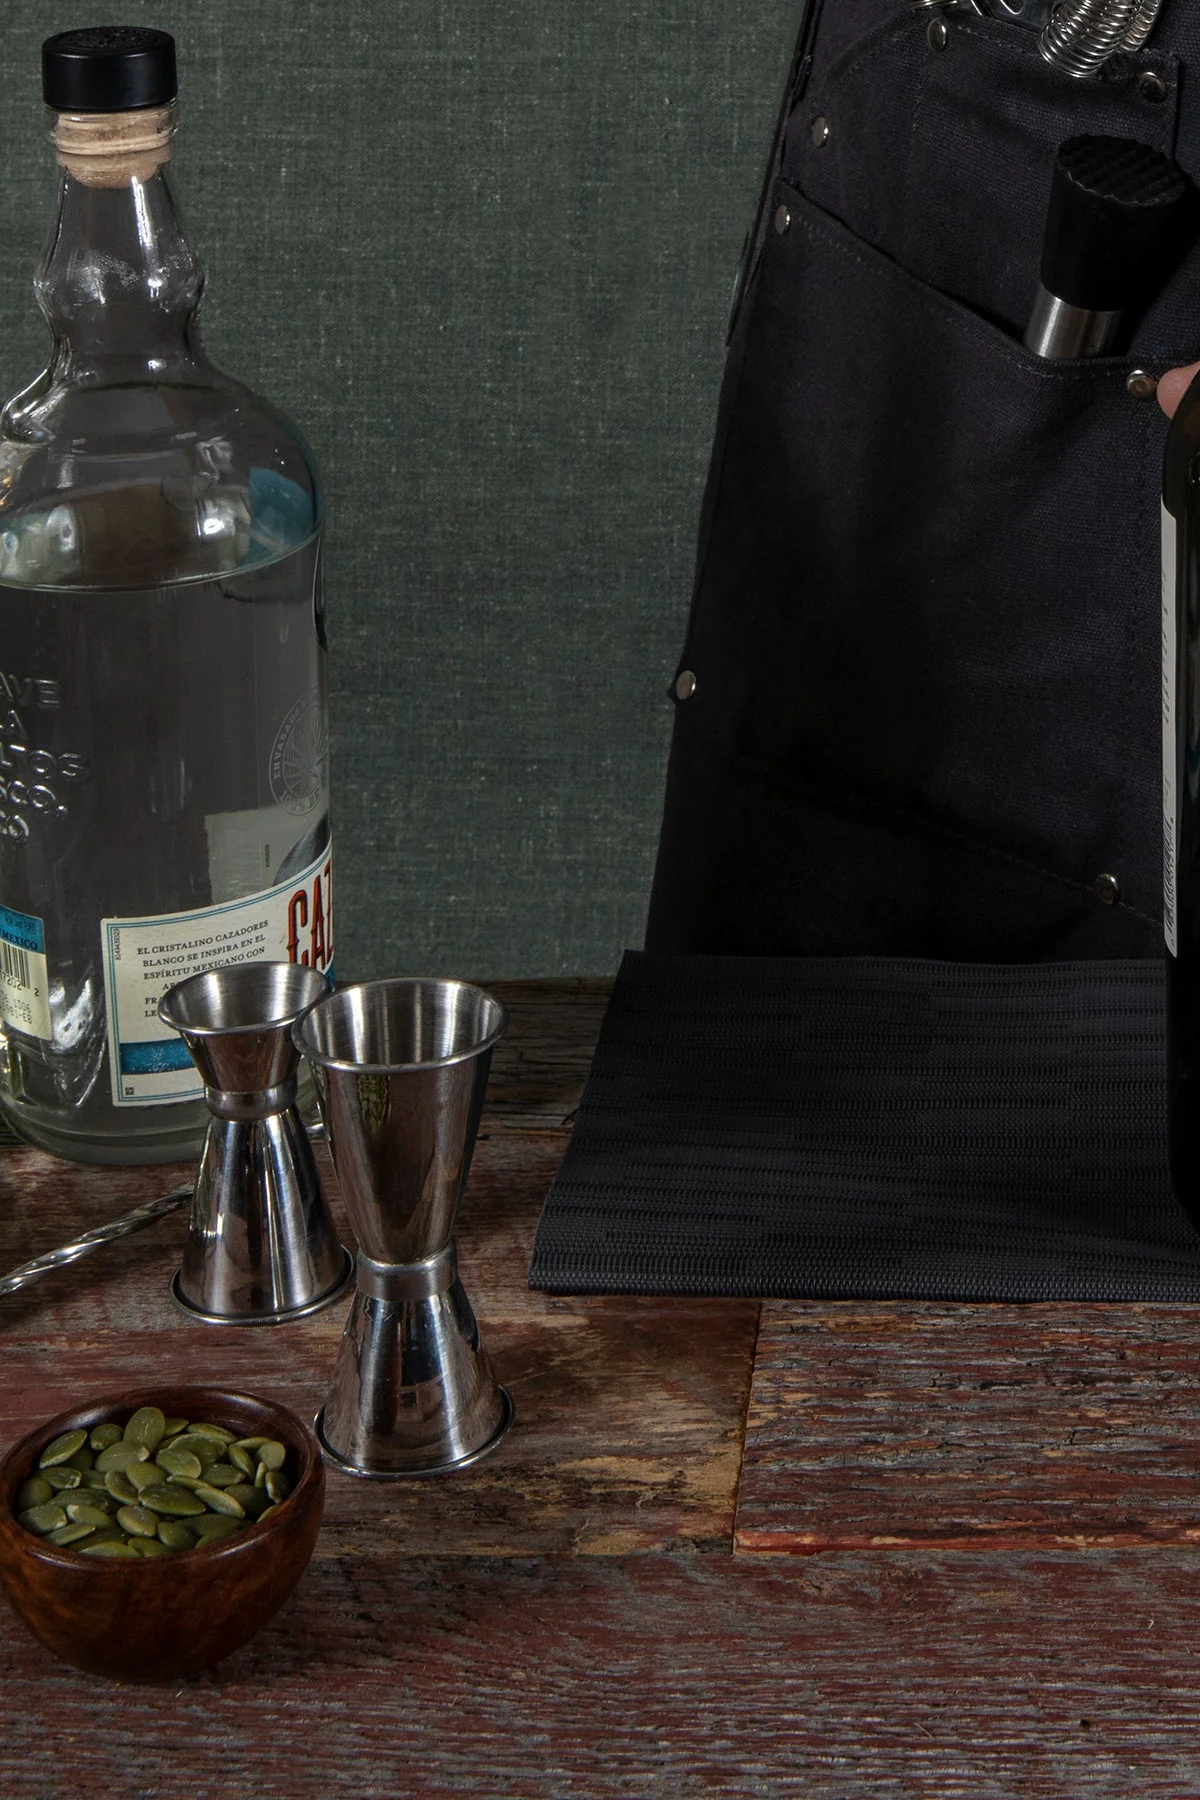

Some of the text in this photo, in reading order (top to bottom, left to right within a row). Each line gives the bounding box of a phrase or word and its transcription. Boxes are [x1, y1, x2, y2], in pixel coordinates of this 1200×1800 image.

[2, 930, 38, 951] MEXICO
[137, 919, 269, 955] EL CRISTALINO CAZADORES
[142, 934, 266, 967] BLANCO SE INSPIRA EN EL
[144, 946, 265, 980] ESPÍRITU MEXICANO CON
